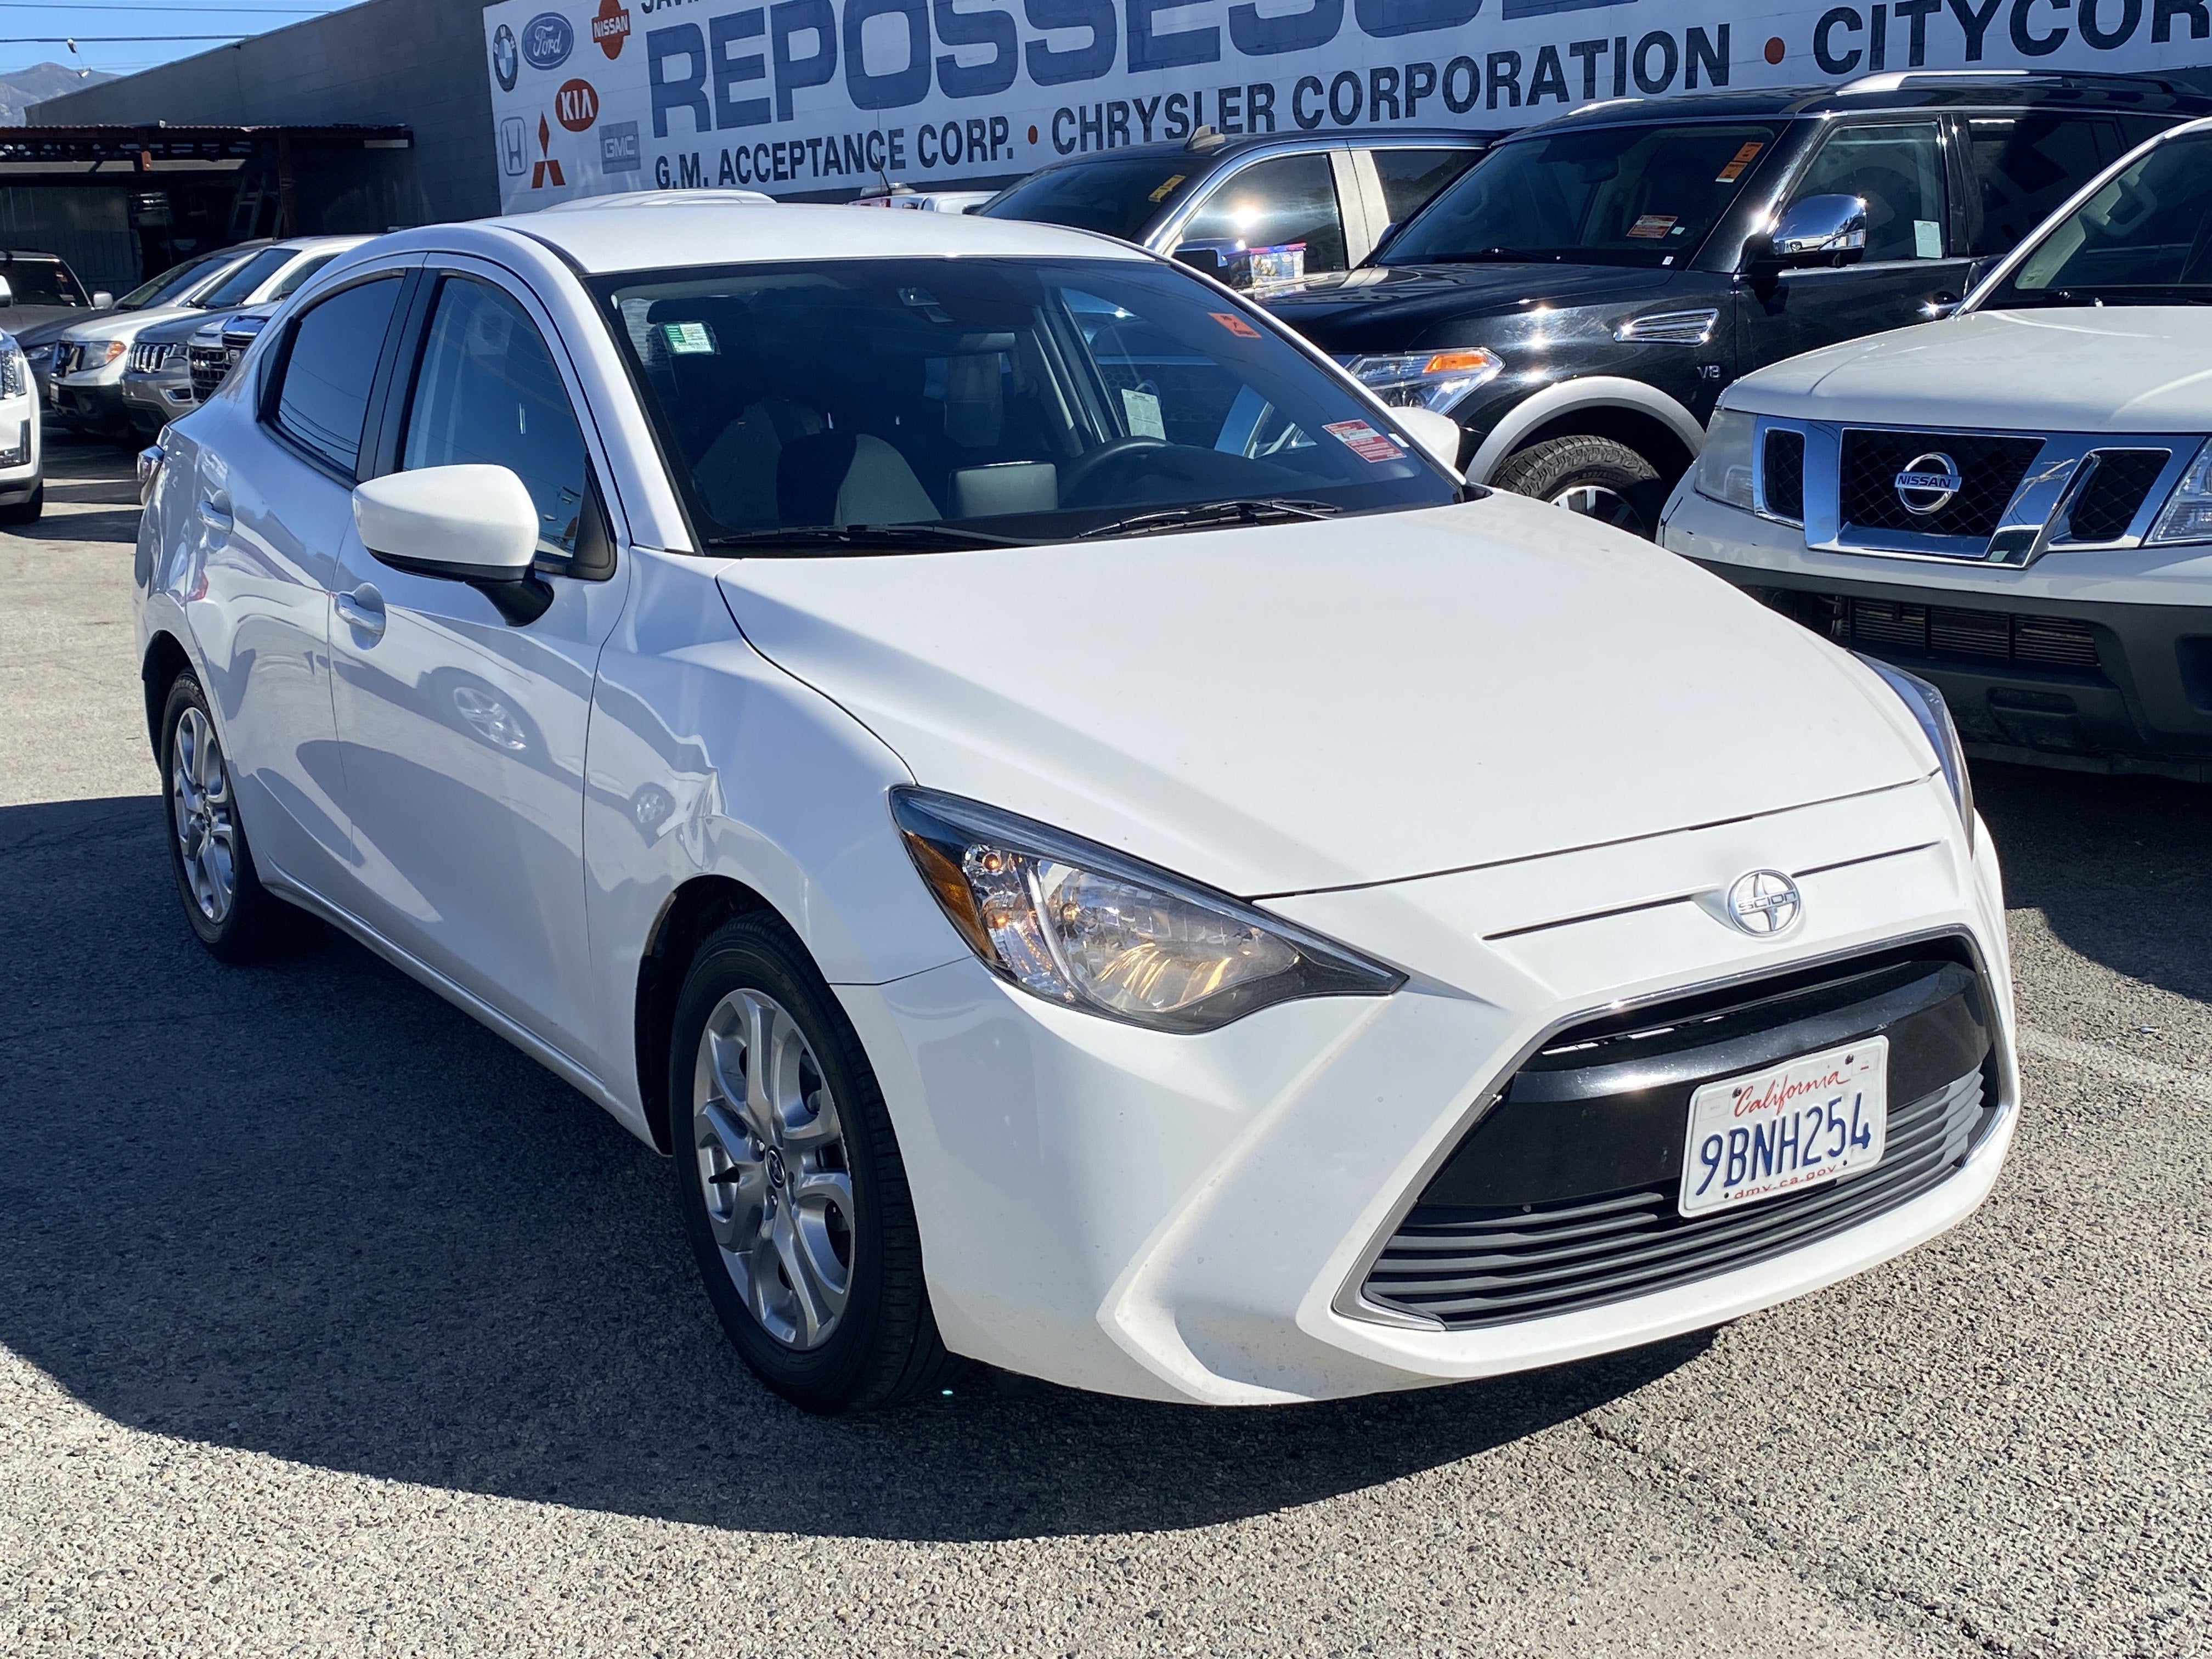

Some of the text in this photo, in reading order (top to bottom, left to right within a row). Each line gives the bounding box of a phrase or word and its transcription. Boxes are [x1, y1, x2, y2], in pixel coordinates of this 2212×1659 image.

[533, 25, 562, 56] Ford
[593, 15, 628, 37] NISSAN
[646, 0, 1638, 138] REPOSS
[561, 88, 594, 121] KIA
[656, 152, 709, 190] G.M.
[718, 127, 905, 185] ACCEPTANCE
[917, 116, 1013, 168] CORP.
[1052, 82, 1276, 155] CHRYSLER
[1291, 23, 1730, 130] CORPORATION
[604, 135, 635, 158] GMC
[1898, 475, 1951, 488] NISSAN
[1738, 891, 1796, 912] SCION
[1734, 1070, 1850, 1118] California
[1696, 1092, 1871, 1196] 9BNH254
[1734, 1164, 1837, 1200] dmv.ca.gov
